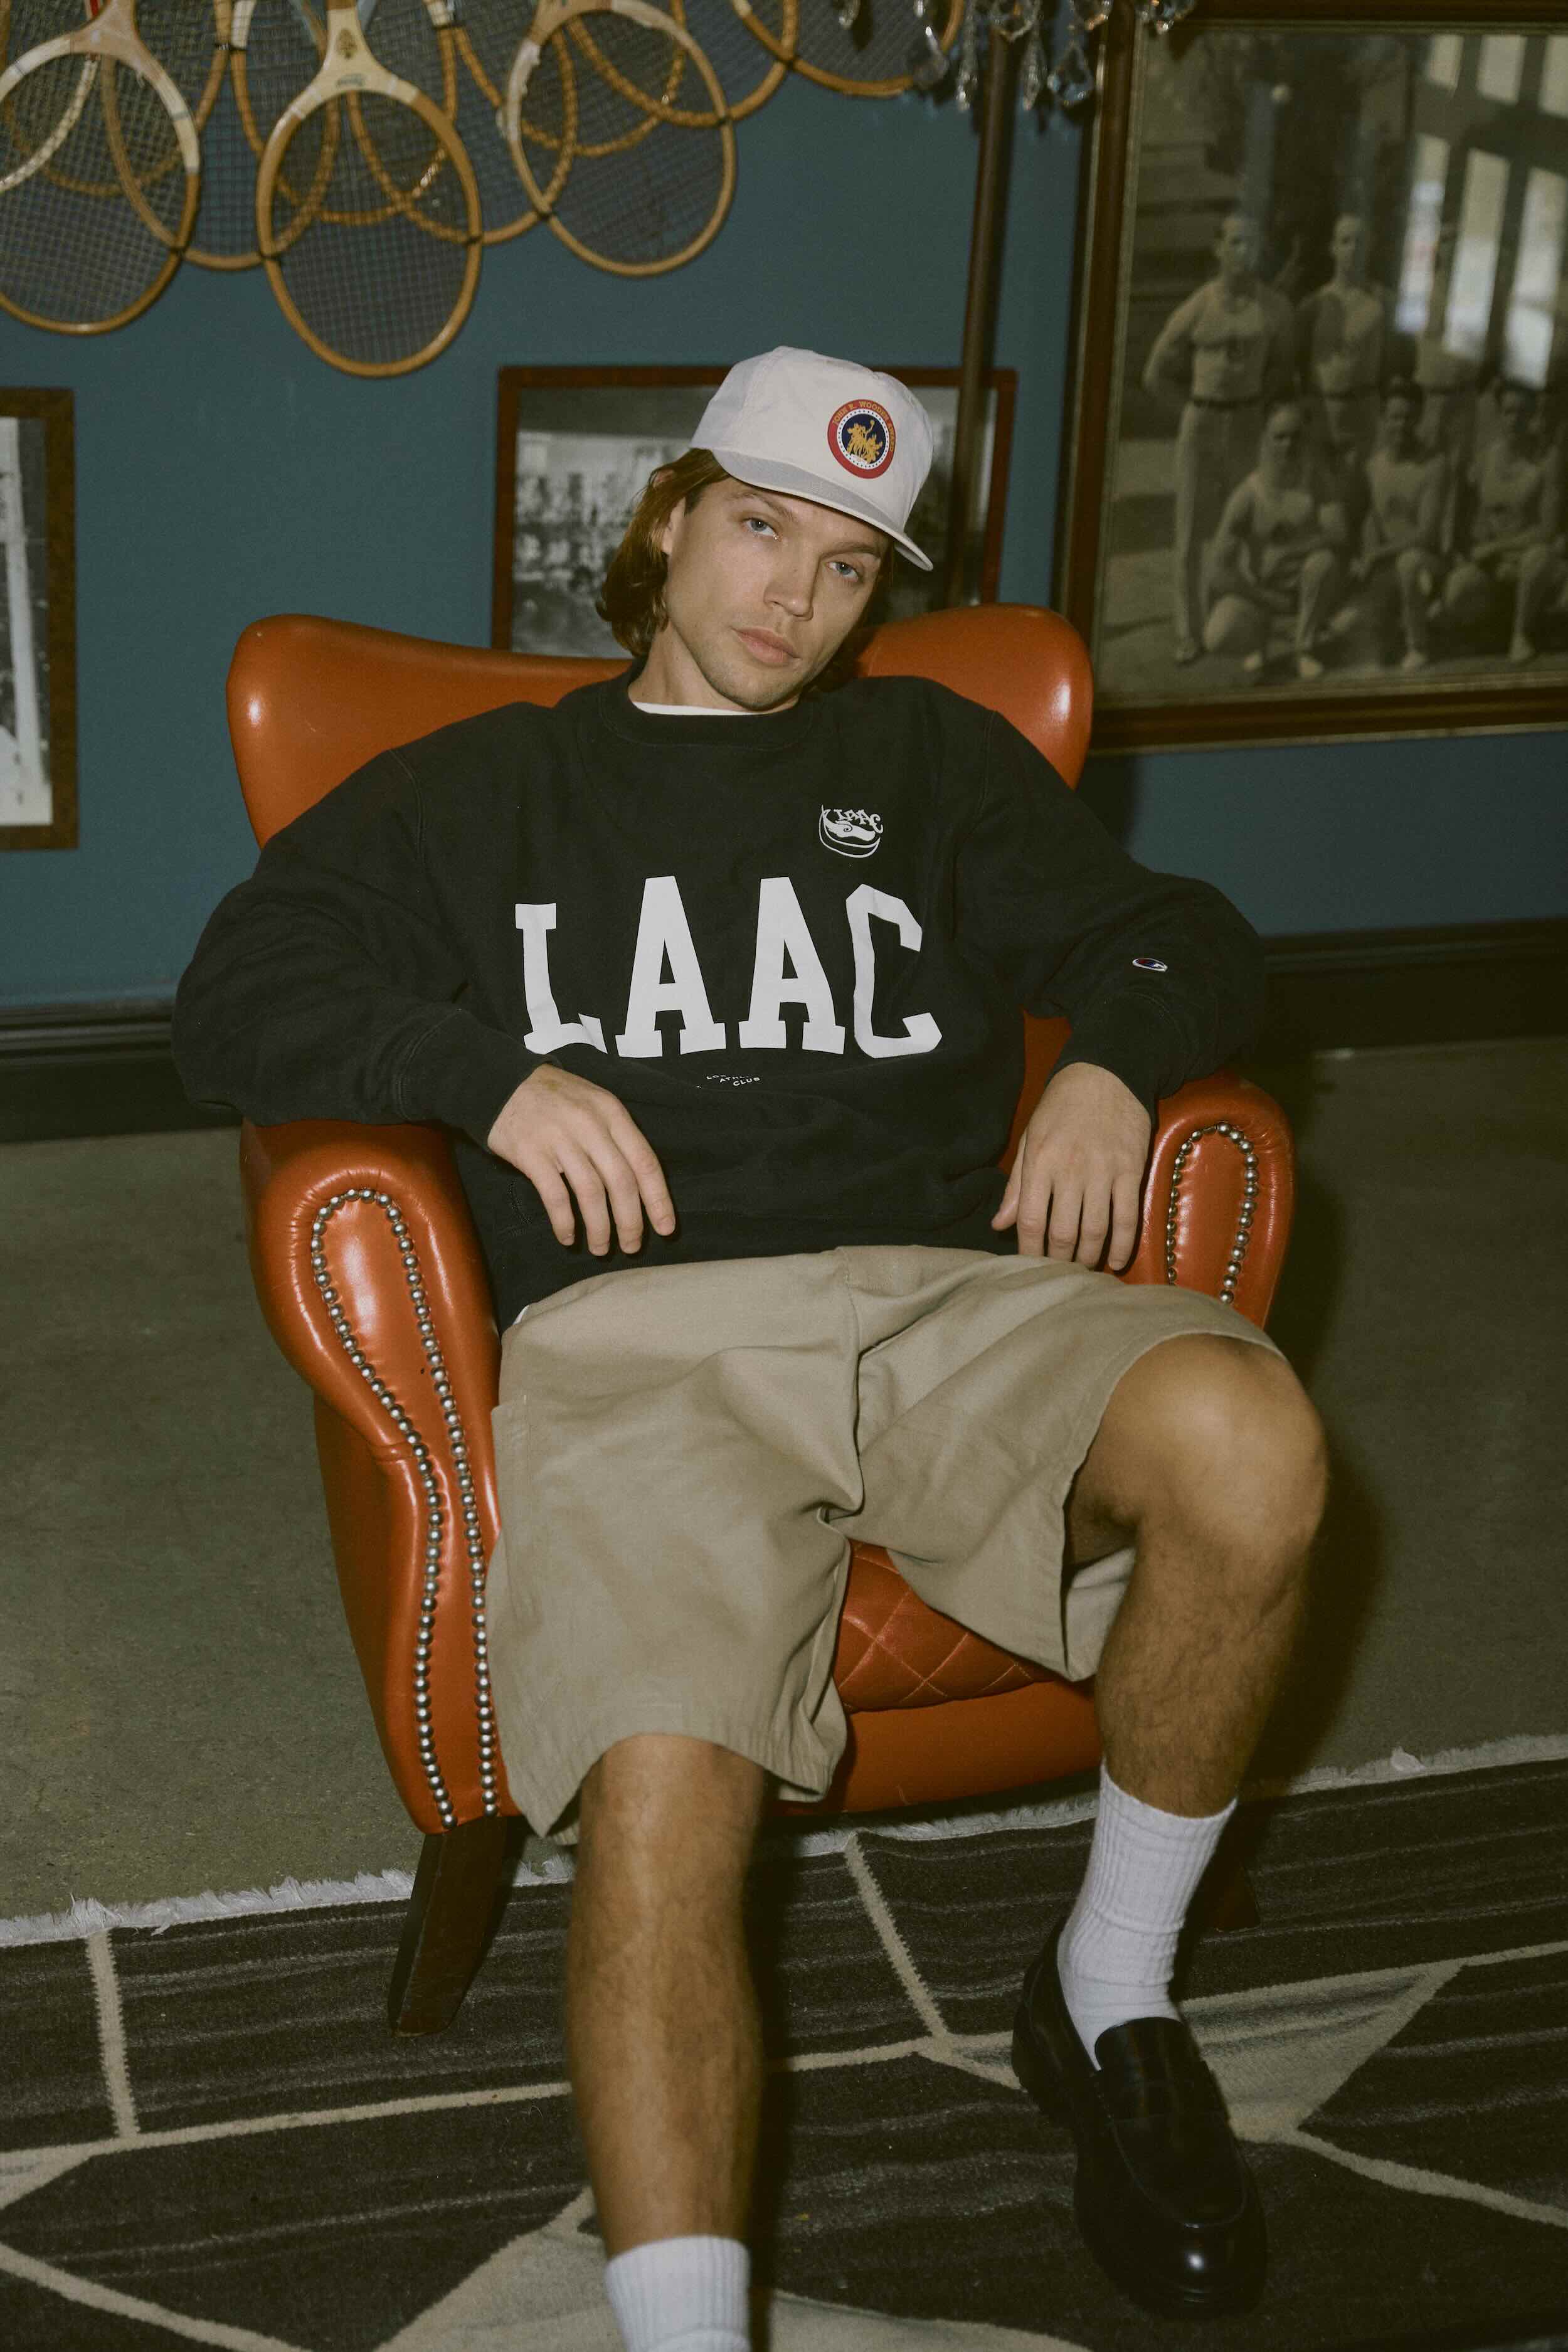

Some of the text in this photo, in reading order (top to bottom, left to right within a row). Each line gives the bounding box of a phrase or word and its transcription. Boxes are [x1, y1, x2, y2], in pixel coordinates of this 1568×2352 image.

[859, 401, 889, 421] WOODEN
[833, 808, 884, 834] LAAC
[515, 876, 942, 1058] LAAC
[733, 1077, 760, 1086] CLUB
